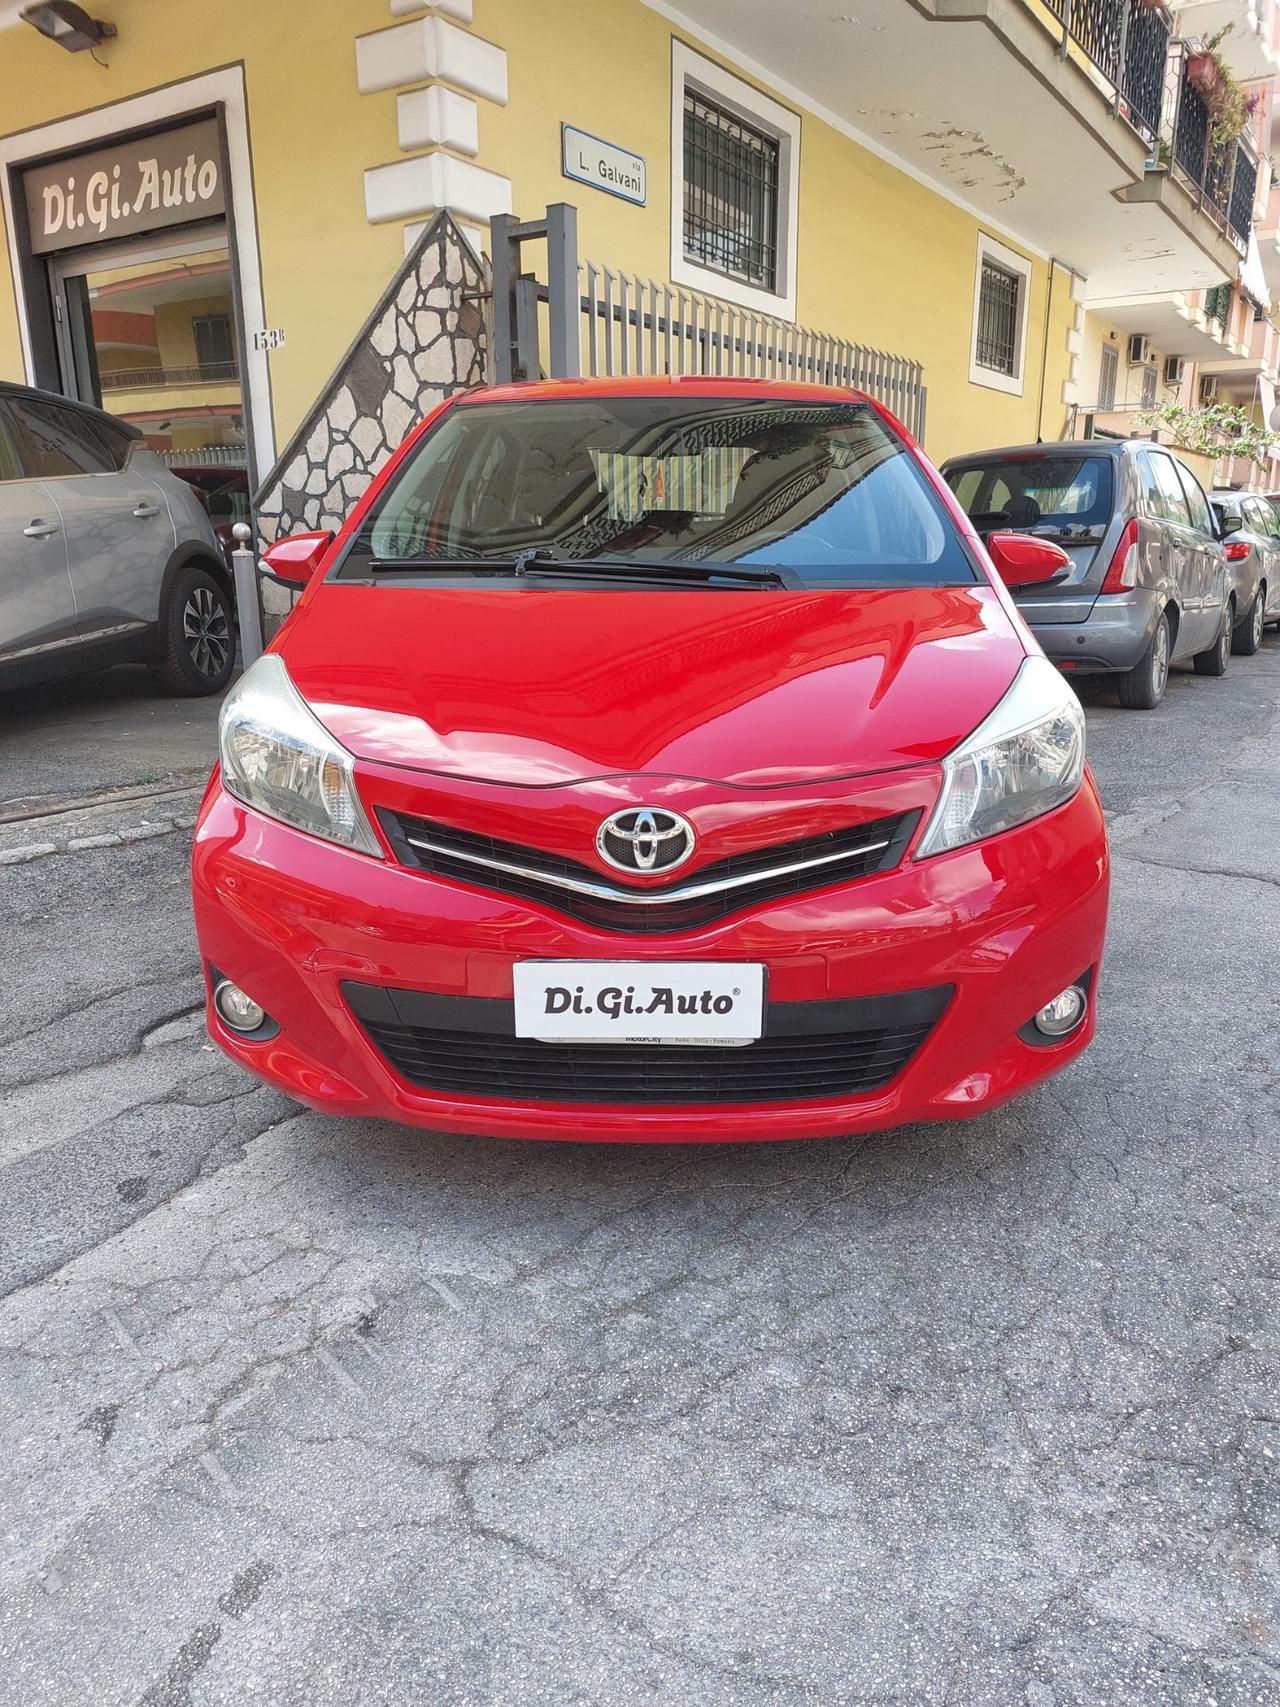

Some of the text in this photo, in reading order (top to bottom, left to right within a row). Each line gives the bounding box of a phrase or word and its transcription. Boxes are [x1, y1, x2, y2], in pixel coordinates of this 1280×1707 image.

[579, 151, 641, 193] L. Galvani
[632, 161, 641, 171] via
[43, 154, 217, 235] Di.Gi.Auto
